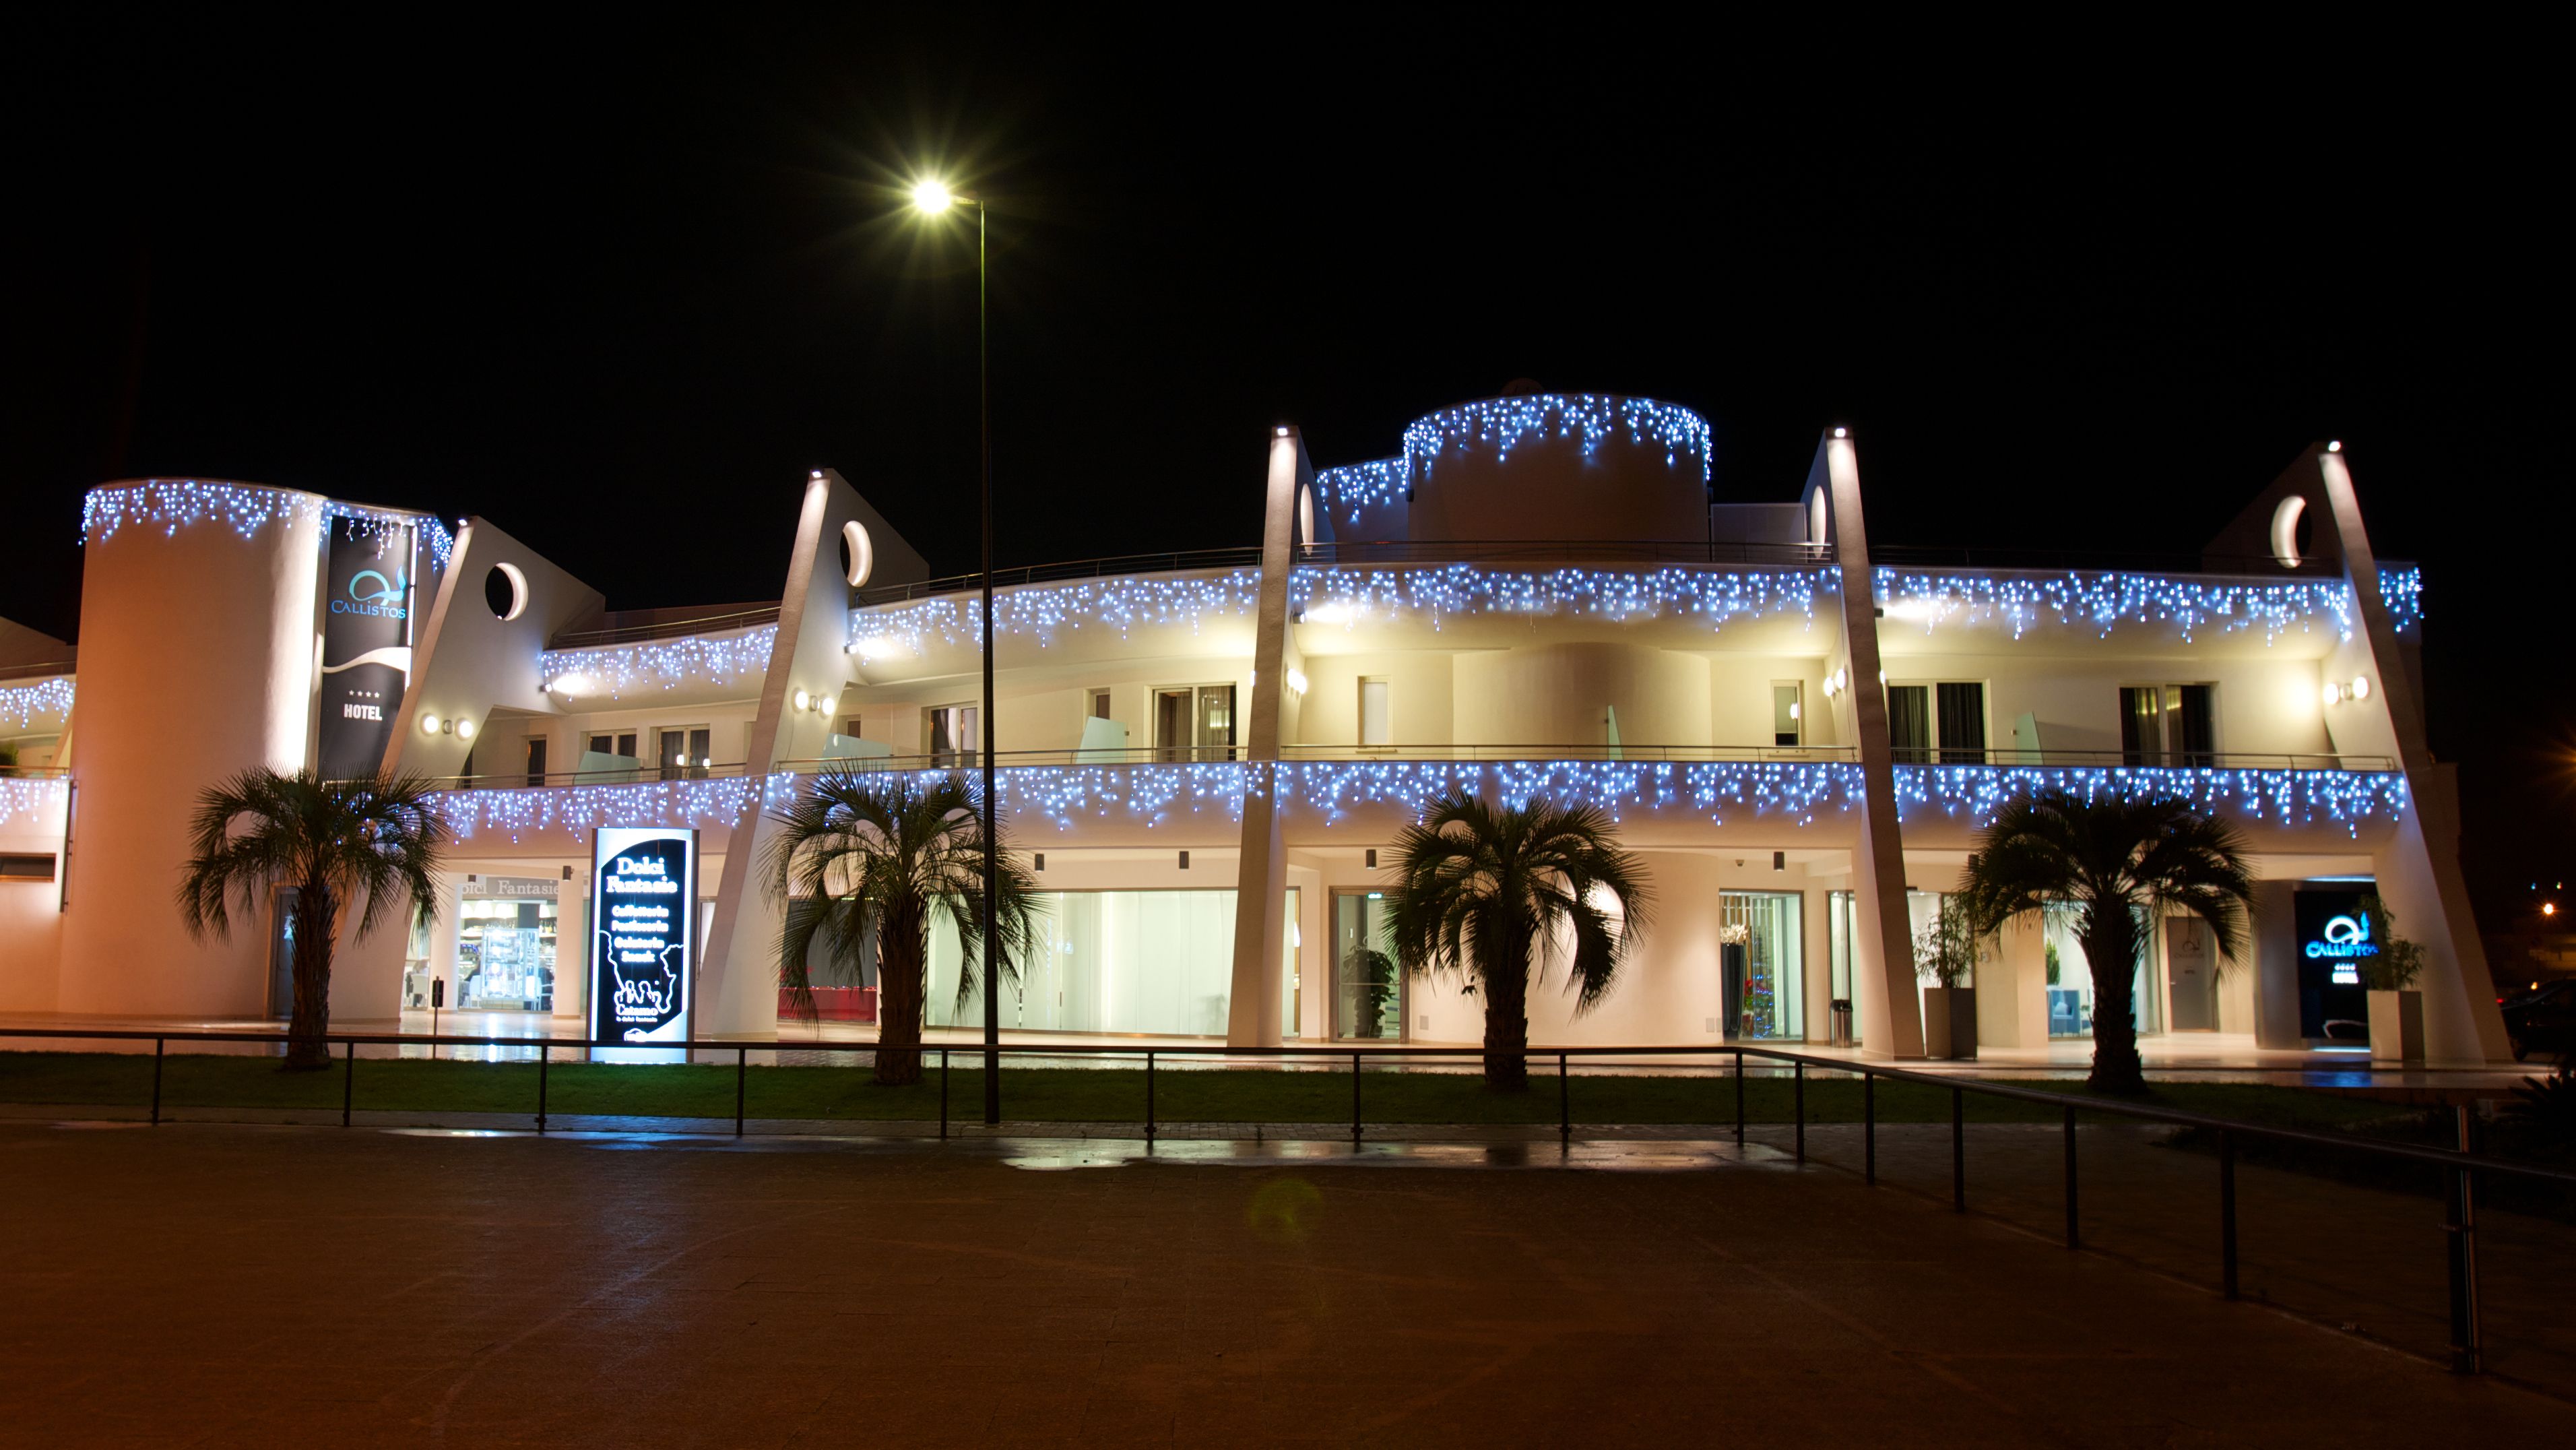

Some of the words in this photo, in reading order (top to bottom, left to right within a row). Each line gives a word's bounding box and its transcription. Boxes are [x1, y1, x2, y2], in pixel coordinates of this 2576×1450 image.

[331, 600, 406, 619] CALLISTOS
[344, 703, 383, 721] HOTEL
[617, 856, 666, 875] Dolci
[497, 880, 559, 895] Fantasie
[606, 875, 678, 893] Fantasie
